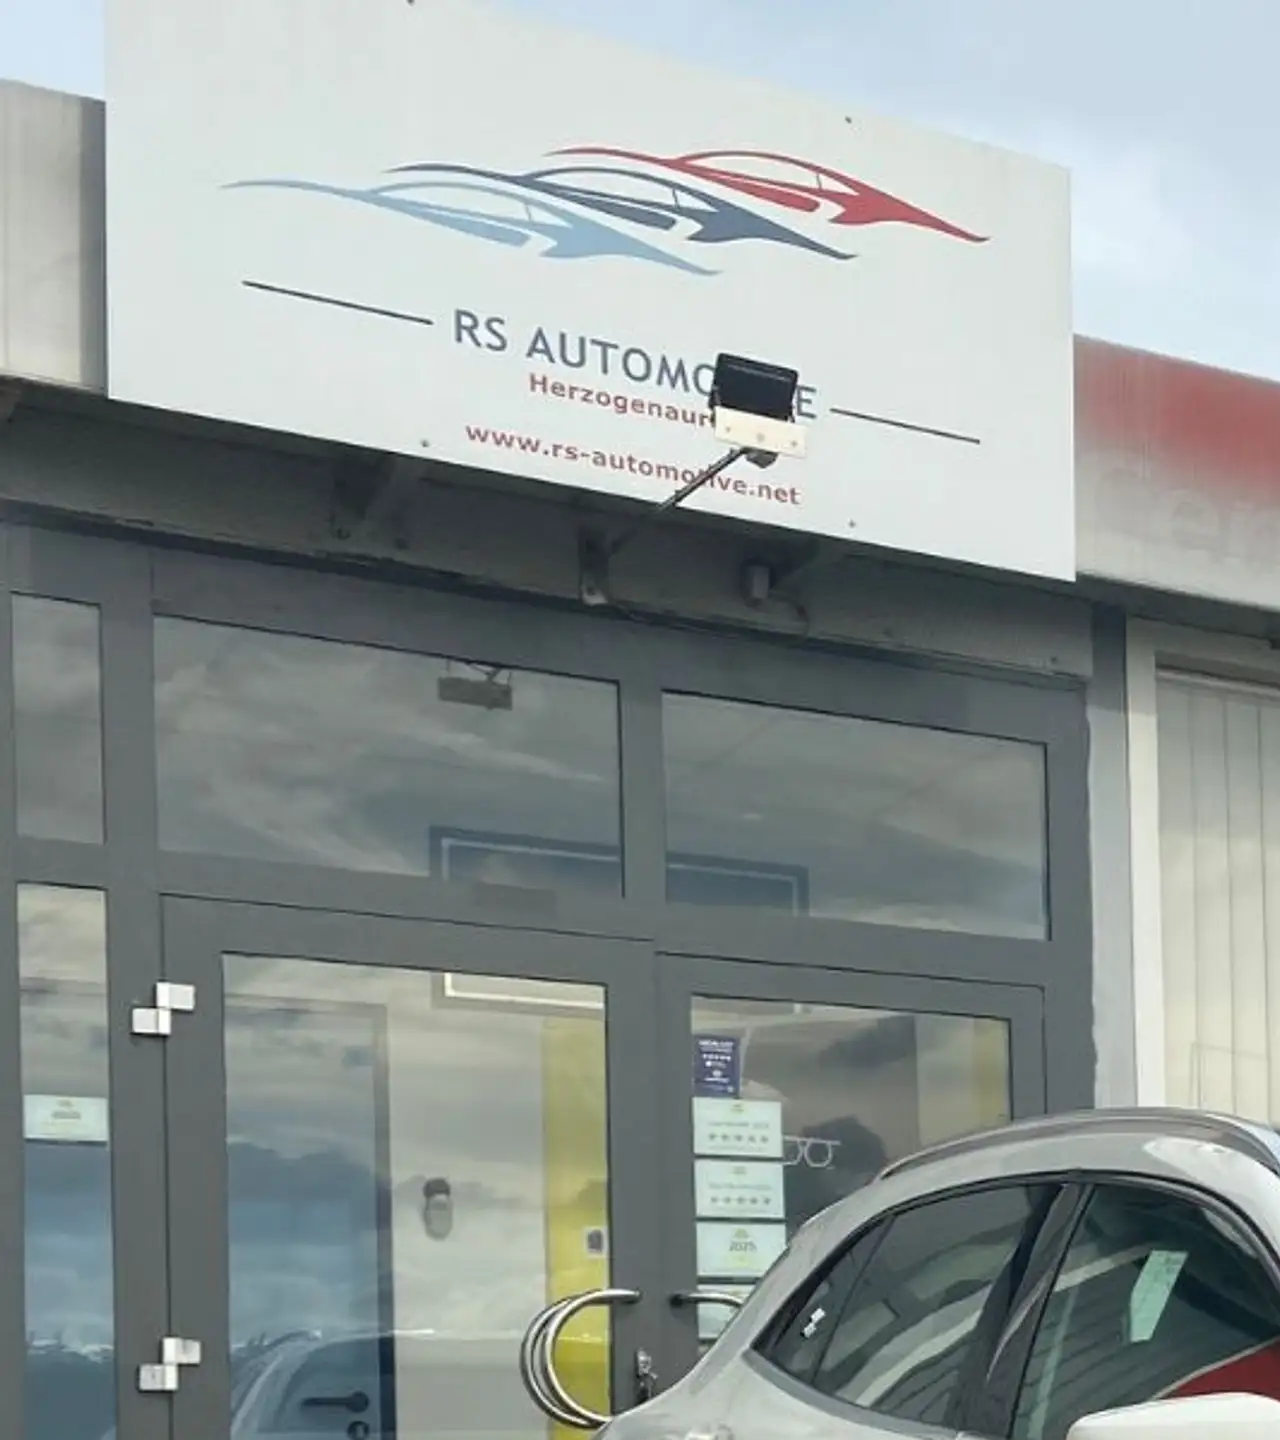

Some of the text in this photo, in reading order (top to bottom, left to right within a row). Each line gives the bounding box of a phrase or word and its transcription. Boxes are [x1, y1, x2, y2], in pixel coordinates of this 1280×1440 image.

[454, 308, 817, 419] RS AUTOMOE
[529, 372, 716, 427] Herzogenaur
